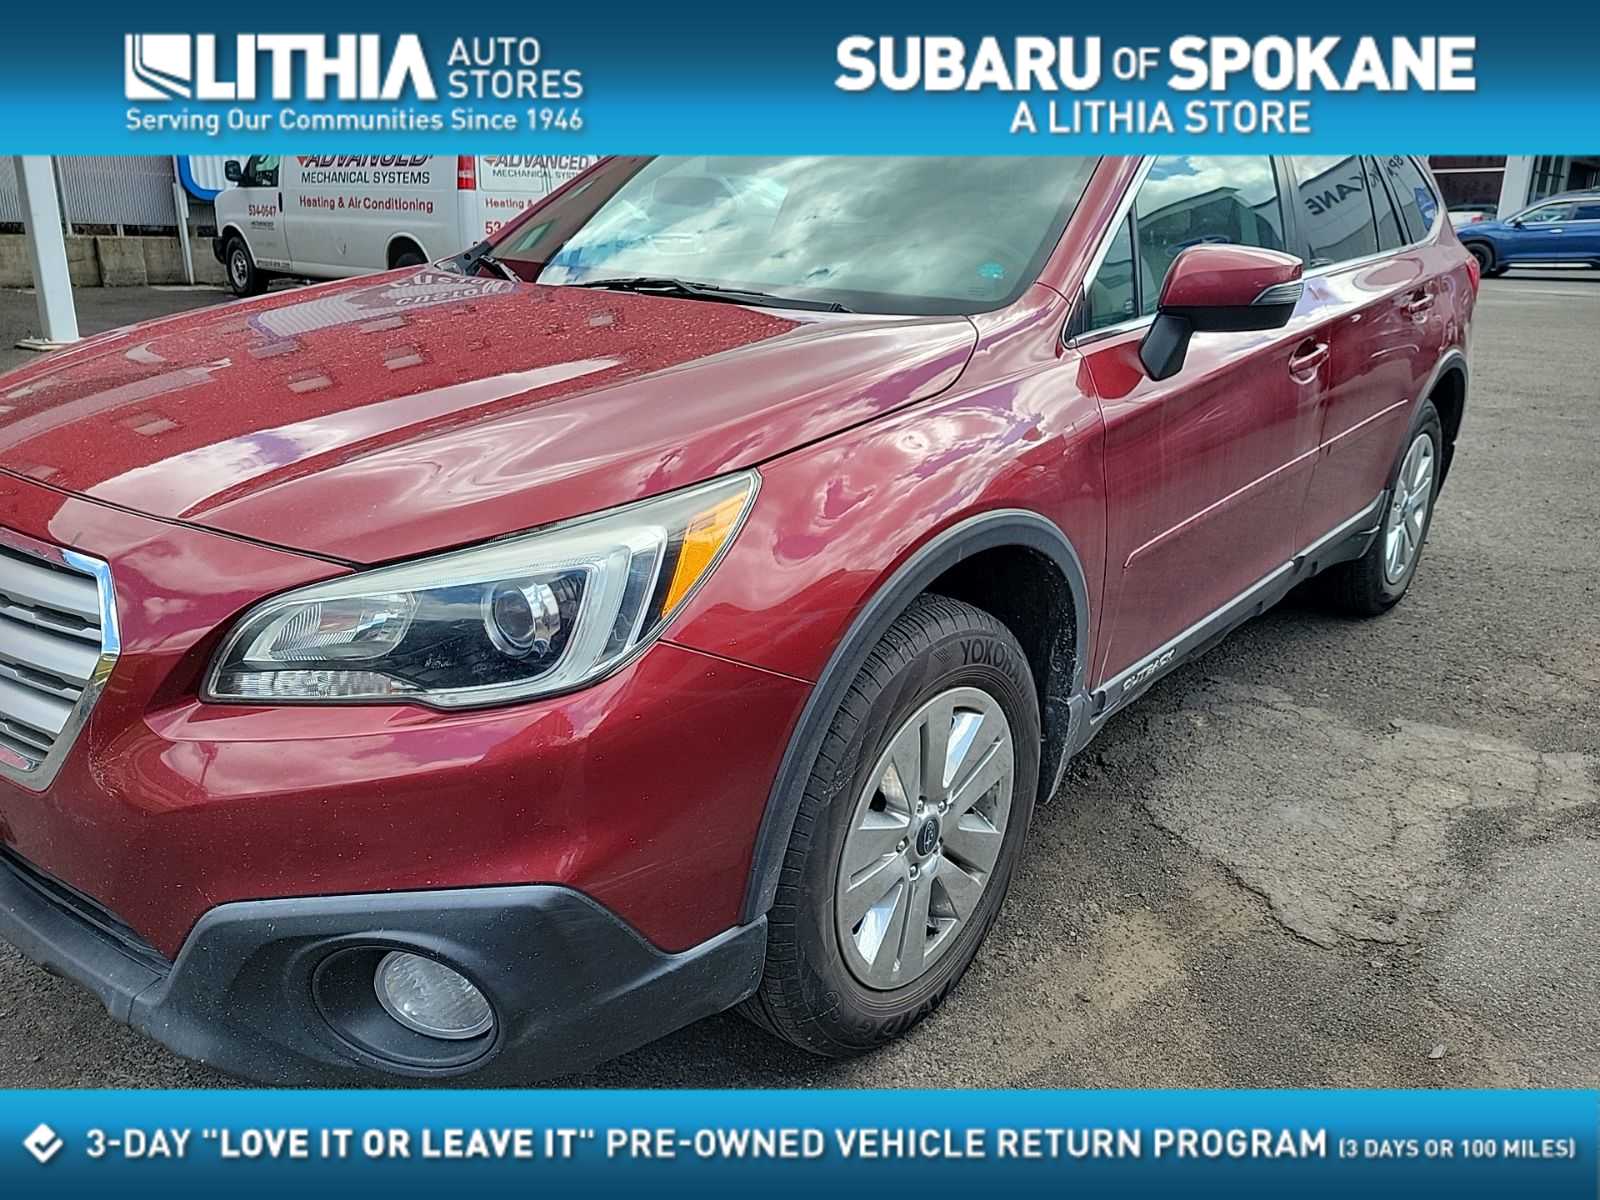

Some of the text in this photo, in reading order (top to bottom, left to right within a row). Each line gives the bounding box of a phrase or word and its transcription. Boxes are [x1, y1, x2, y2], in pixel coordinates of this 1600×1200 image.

[301, 171, 431, 185] MECHANICAL SYSTEMS
[299, 195, 434, 213] Heating & Air Conditioning
[485, 198, 524, 210] Heating
